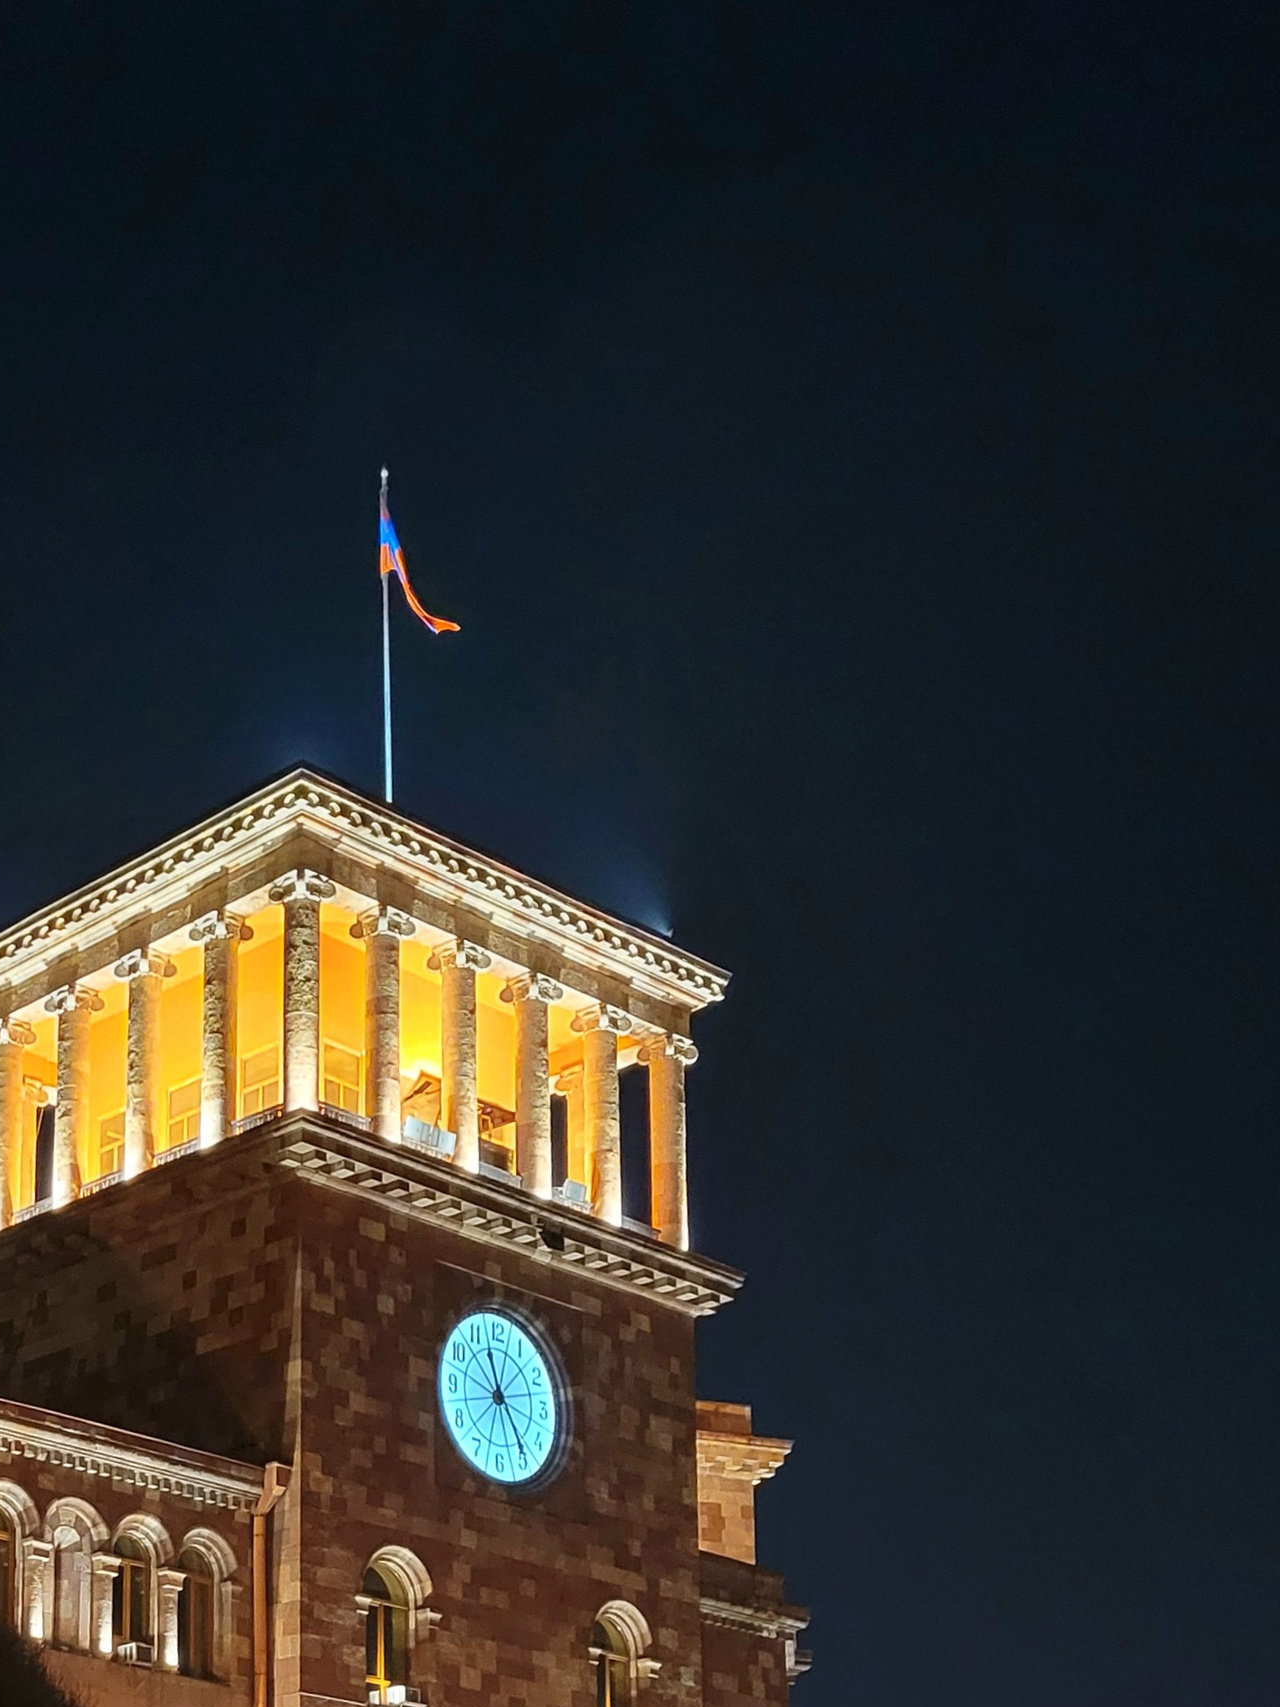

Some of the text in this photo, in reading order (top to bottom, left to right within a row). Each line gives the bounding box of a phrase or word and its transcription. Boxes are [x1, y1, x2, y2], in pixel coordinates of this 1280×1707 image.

[470, 1323, 480, 1345] 11
[492, 1321, 505, 1344] 12
[453, 1341, 465, 1363] 10
[518, 1338, 522, 1358] 1
[448, 1373, 458, 1393] 9
[532, 1367, 542, 1387] 2
[455, 1408, 464, 1429] 8
[539, 1400, 548, 1420] 3
[471, 1437, 481, 1457] 7
[534, 1431, 543, 1451] 4
[495, 1453, 505, 1473] 6
[518, 1449, 528, 1470] 5
